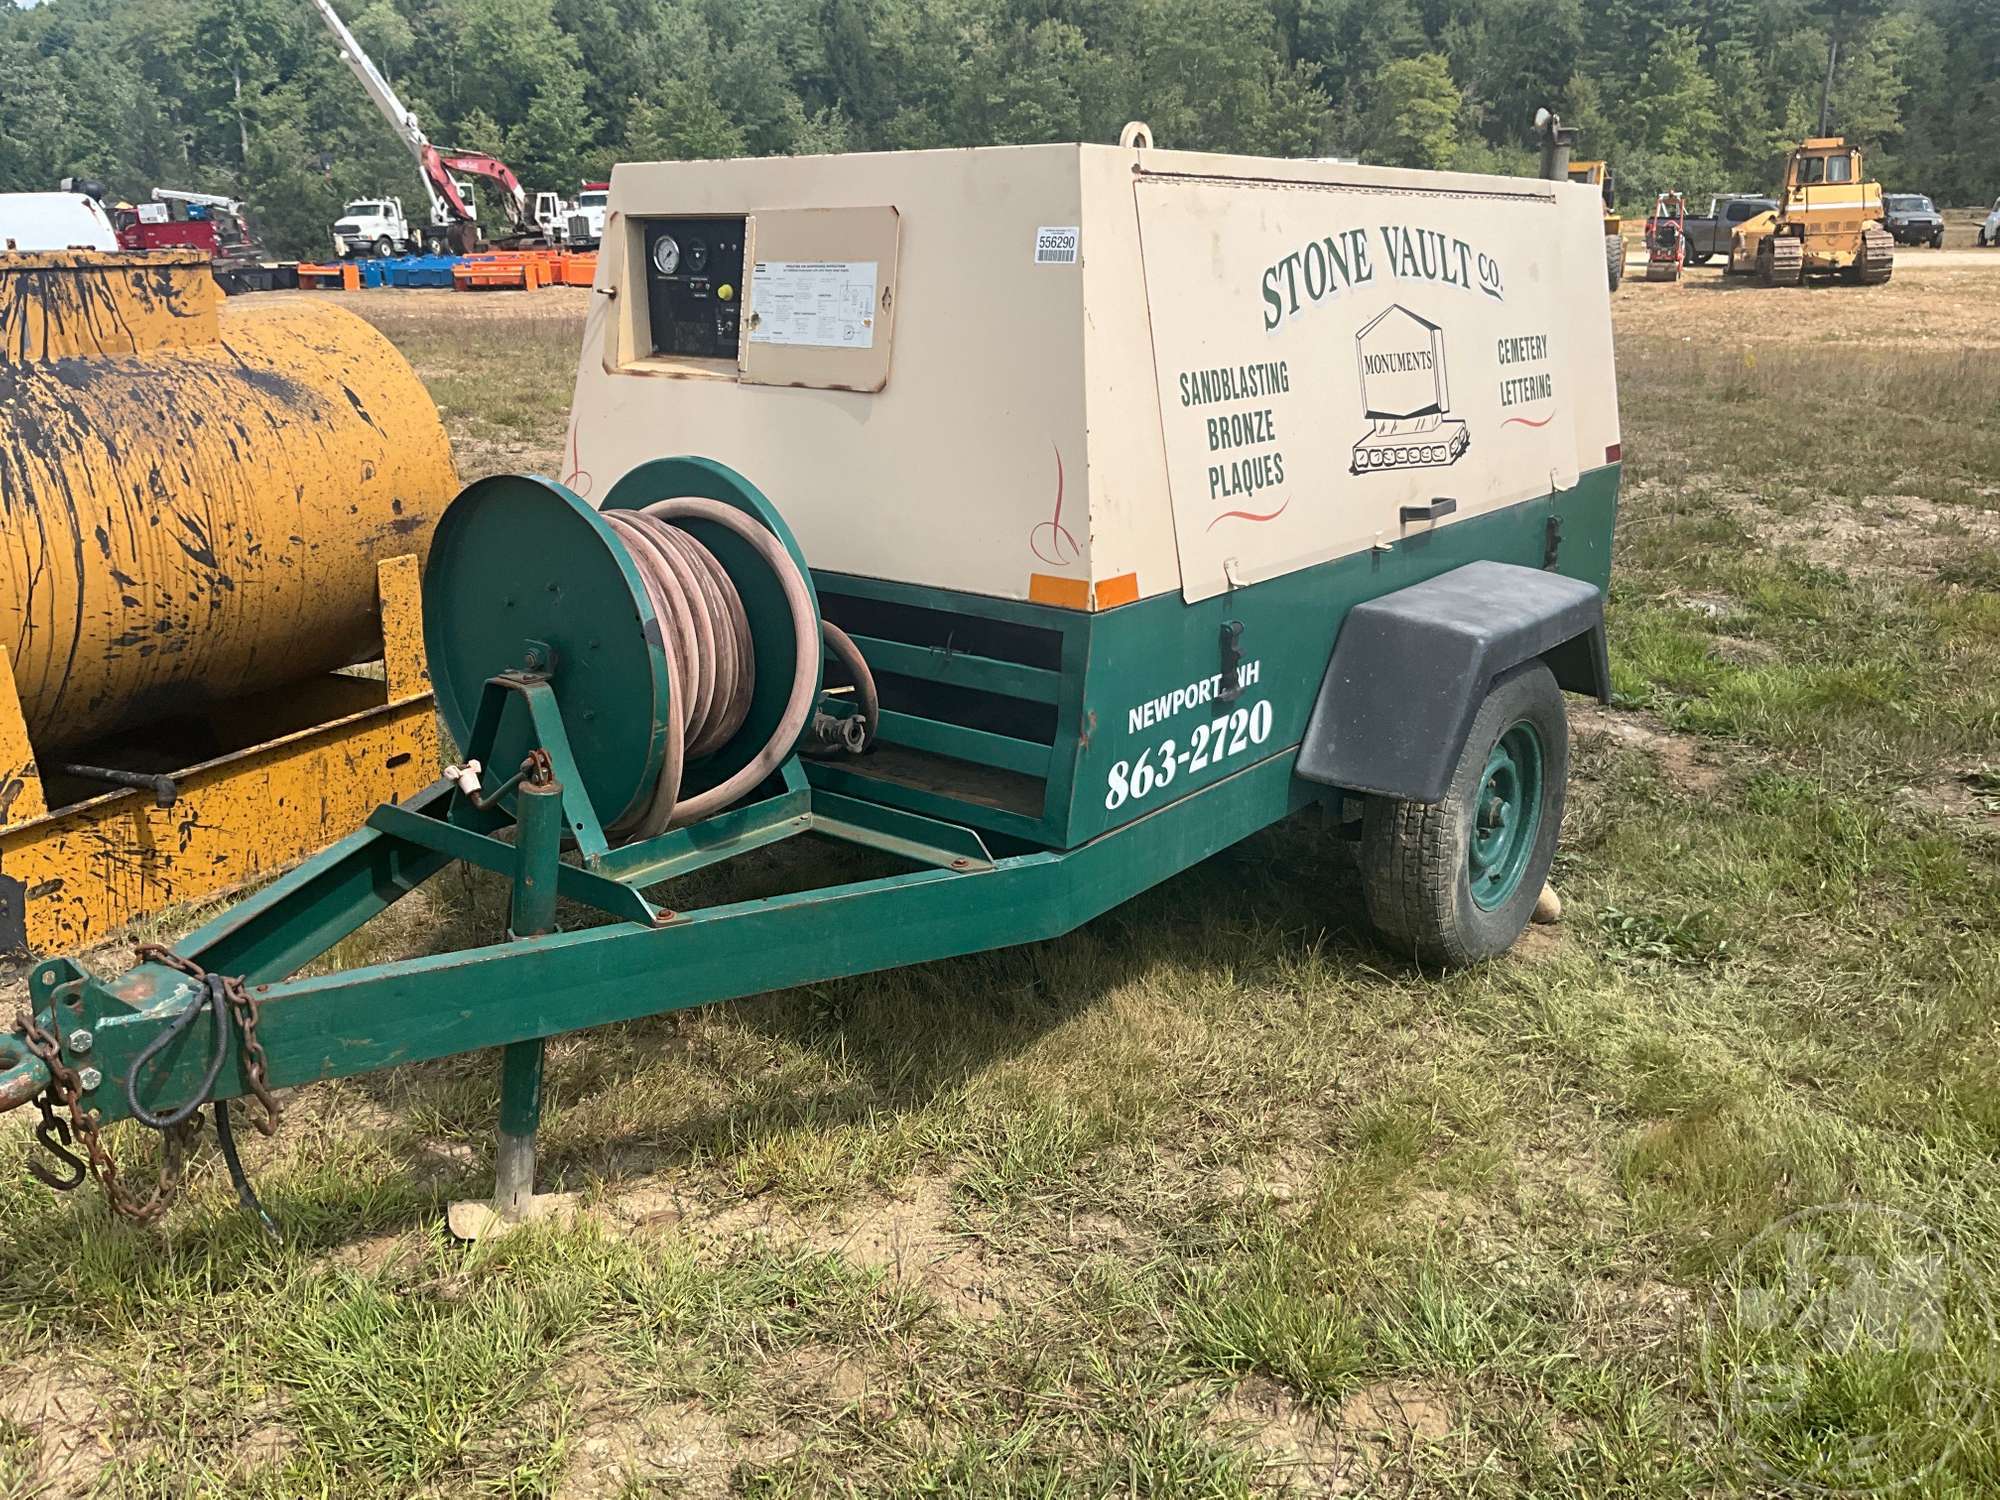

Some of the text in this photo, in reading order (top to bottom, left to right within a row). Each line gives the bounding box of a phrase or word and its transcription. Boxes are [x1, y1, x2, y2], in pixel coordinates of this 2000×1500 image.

[1039, 235, 1075, 249] 556290
[1262, 228, 1373, 332] STONE
[1379, 225, 1472, 290] VAULT
[1364, 350, 1433, 375] MONUMENTS
[1497, 334, 1548, 365] CEMETERY
[1179, 360, 1290, 407] SANDBLASTING
[1499, 373, 1552, 407] LETTERING
[1206, 409, 1276, 451] BRONZE
[1208, 452, 1285, 500] PLAQUES
[1128, 673, 1223, 735] NEWPORT
[1104, 699, 1273, 810] 863-2720
